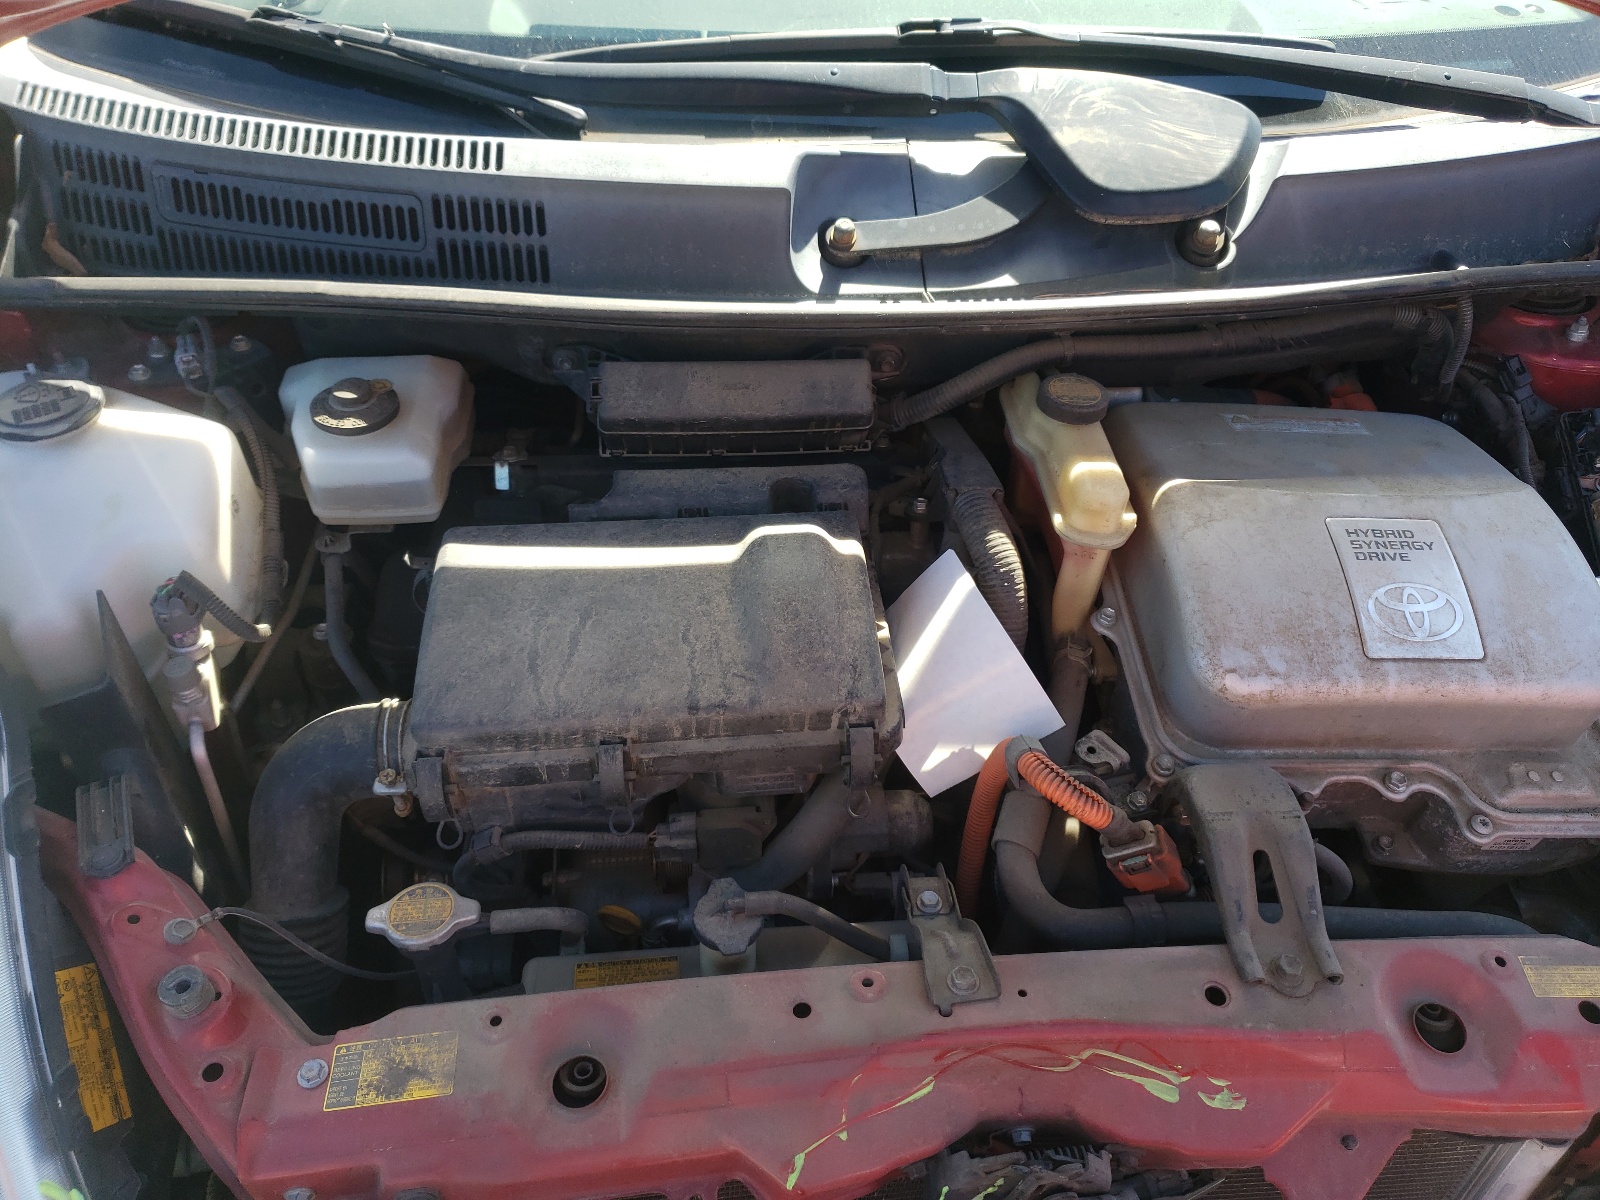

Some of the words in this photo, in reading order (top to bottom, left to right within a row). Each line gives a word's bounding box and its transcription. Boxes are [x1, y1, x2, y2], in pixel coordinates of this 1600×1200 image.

[1345, 528, 1414, 539] HYBRID
[1350, 540, 1434, 551] SYNERGY
[1354, 551, 1411, 562] DRIVE
[331, 1071, 358, 1079] COOLANT
